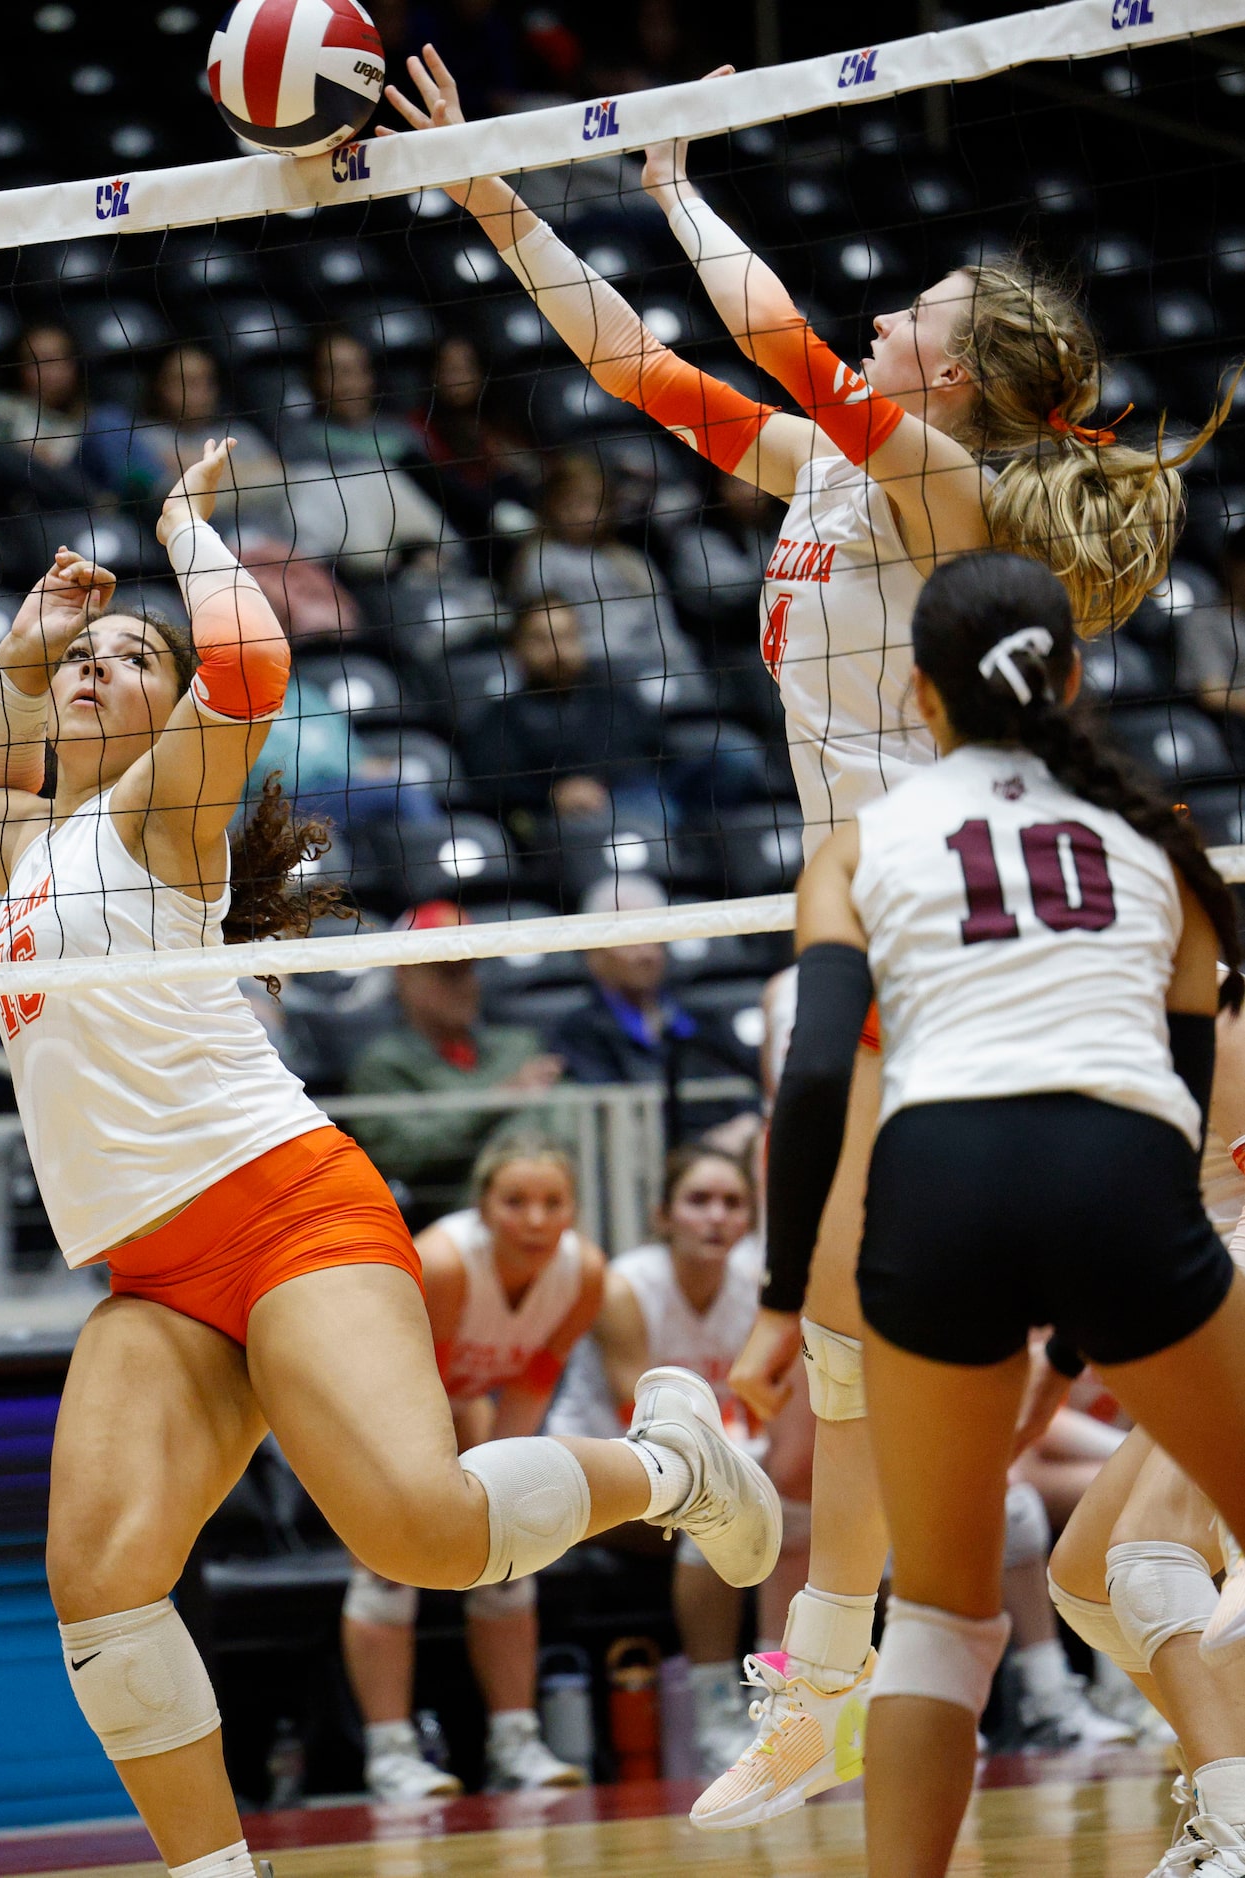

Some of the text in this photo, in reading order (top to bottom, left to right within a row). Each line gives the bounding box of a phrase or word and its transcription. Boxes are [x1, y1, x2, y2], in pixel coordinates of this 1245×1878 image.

[353, 60, 385, 94] aden
[837, 48, 878, 88] UIL
[583, 99, 619, 140] UIL
[332, 142, 371, 183] UIL
[96, 179, 130, 219] UIL
[764, 538, 836, 583] ELINA
[945, 819, 1117, 945] 10
